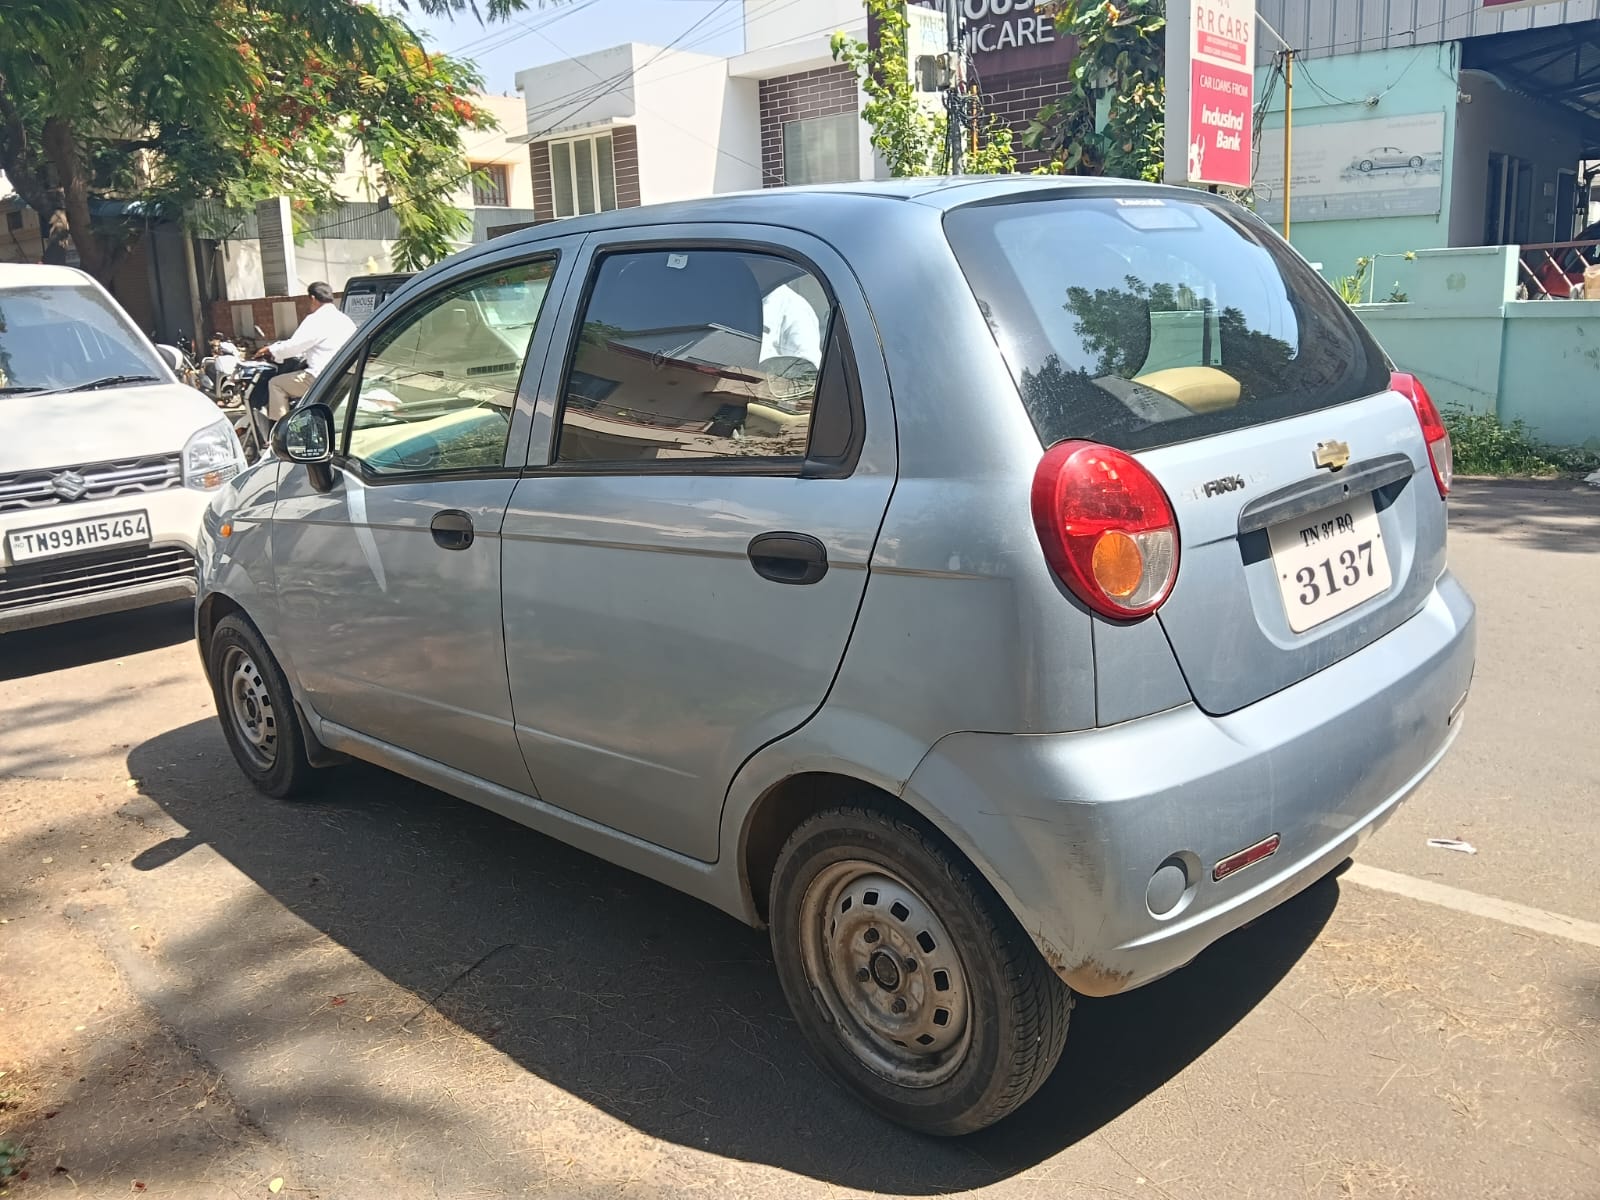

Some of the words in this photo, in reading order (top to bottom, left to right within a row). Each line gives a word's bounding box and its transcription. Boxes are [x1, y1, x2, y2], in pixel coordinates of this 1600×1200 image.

[1218, 13, 1249, 42] CARS
[1199, 74, 1213, 89] CAR
[1216, 130, 1241, 151] Bank
[23, 517, 146, 553] TN99AH5464
[1300, 525, 1320, 547] TN
[1321, 520, 1334, 540] 37
[1335, 513, 1355, 534] BQ
[1296, 540, 1374, 605] 3137
